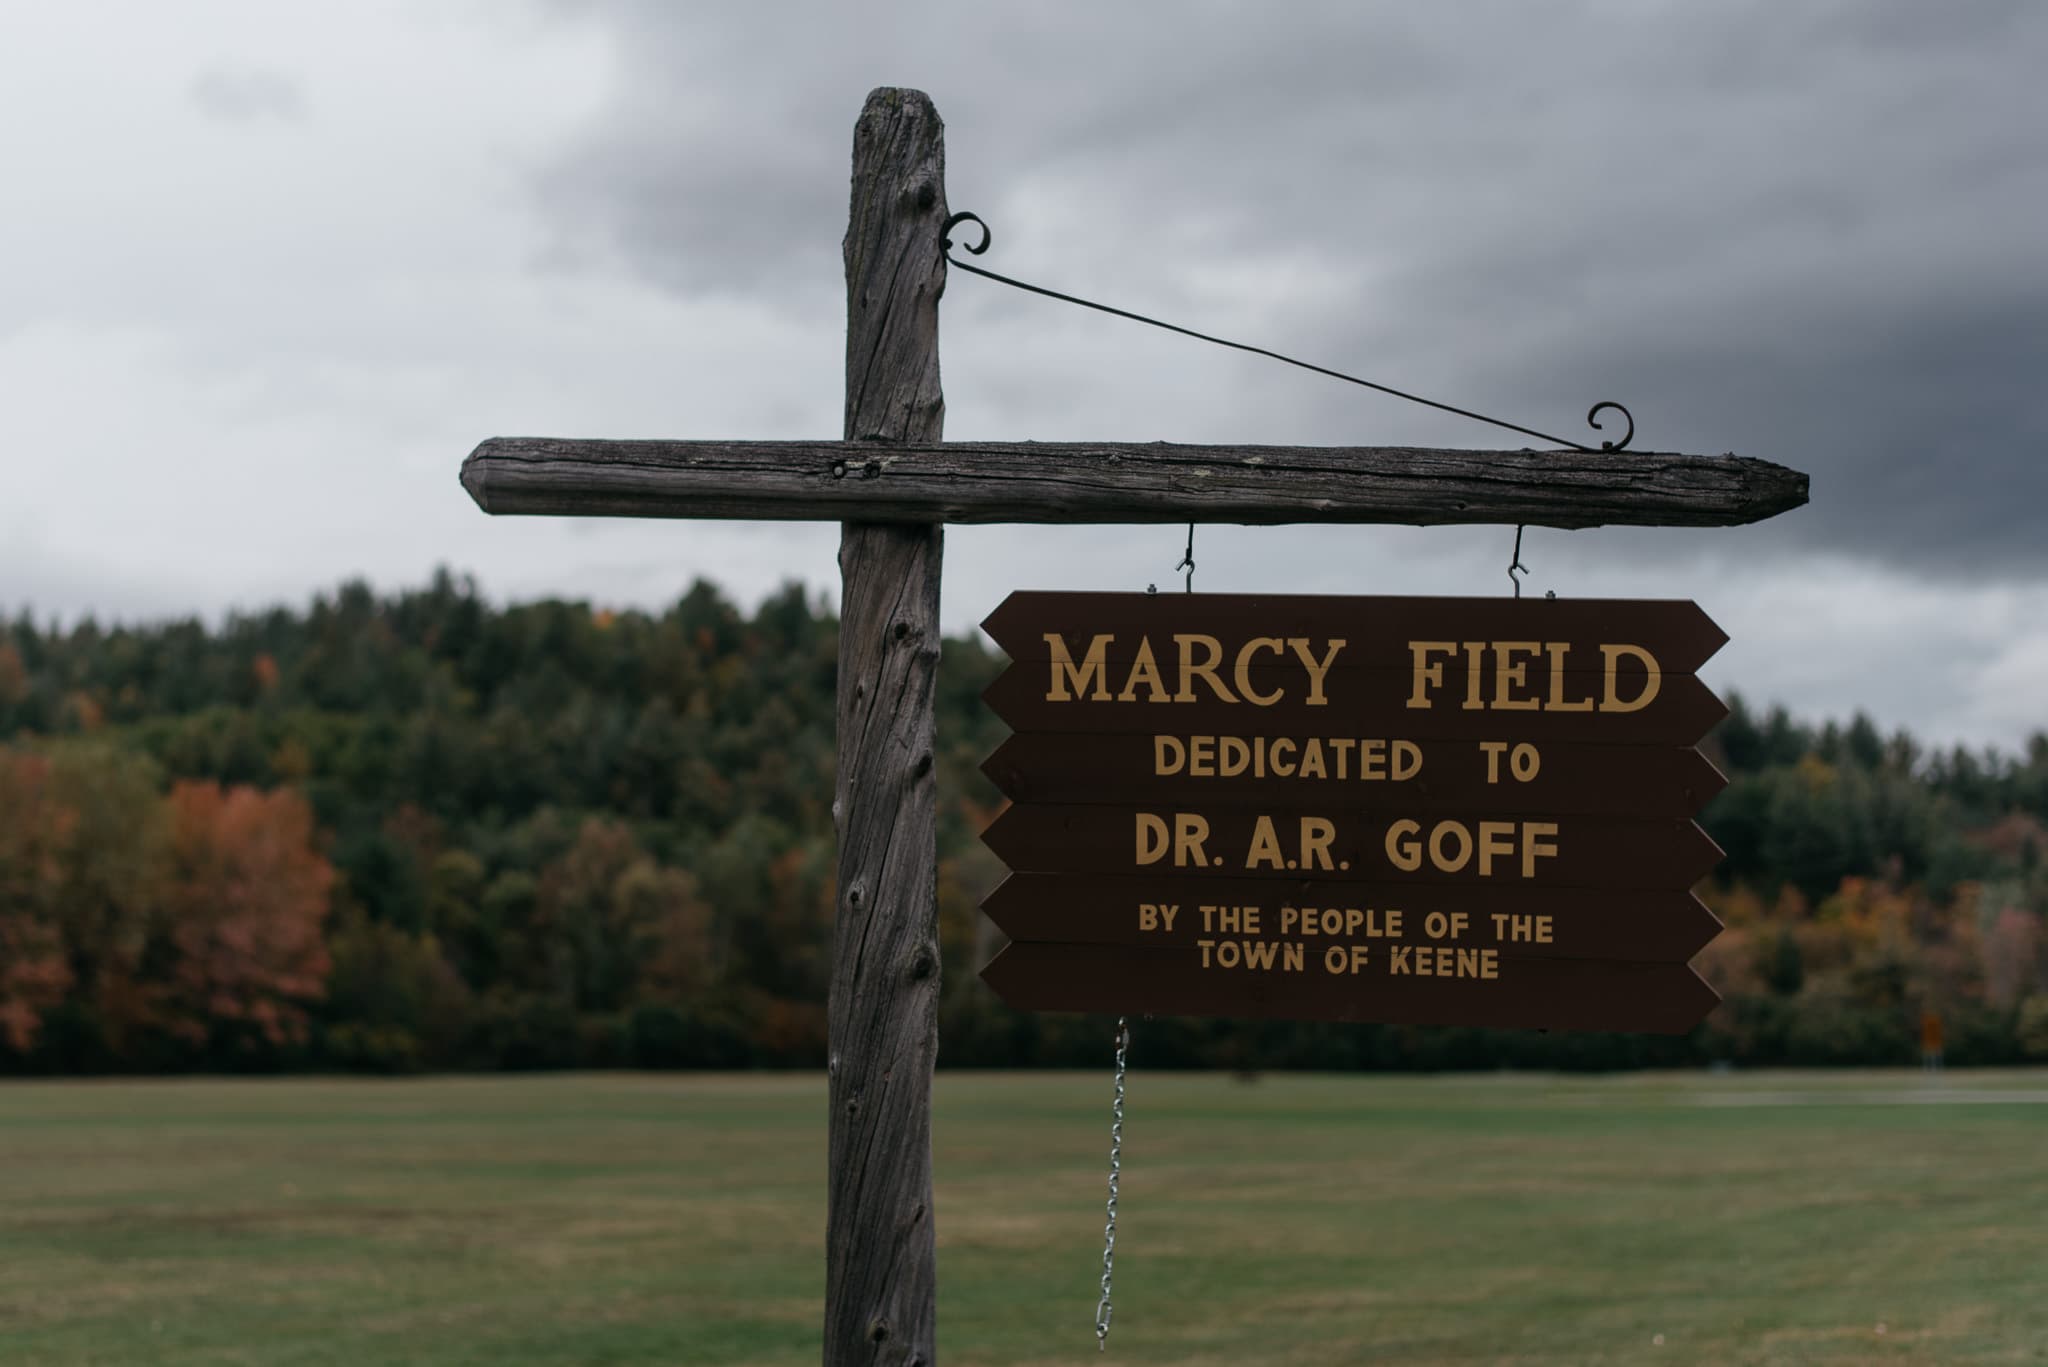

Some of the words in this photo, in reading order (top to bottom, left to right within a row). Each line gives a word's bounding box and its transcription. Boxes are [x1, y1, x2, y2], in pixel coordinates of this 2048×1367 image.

[1043, 633, 1347, 706] MARCY
[1407, 641, 1661, 713] FIELD
[1154, 735, 1423, 781] DEDICATED
[1479, 742, 1540, 783] TO
[1135, 813, 1223, 867] DR.
[1246, 815, 1350, 871] A.R.
[1385, 819, 1559, 878] GOFF
[1139, 904, 1178, 931] BY
[1199, 906, 1260, 934] THE
[1281, 908, 1403, 938] PEOPLE
[1424, 912, 1469, 939] OF
[1491, 914, 1554, 943] THE
[1197, 940, 1304, 971] TOWN
[1325, 945, 1369, 975] OF
[1390, 946, 1499, 979] KEENE
